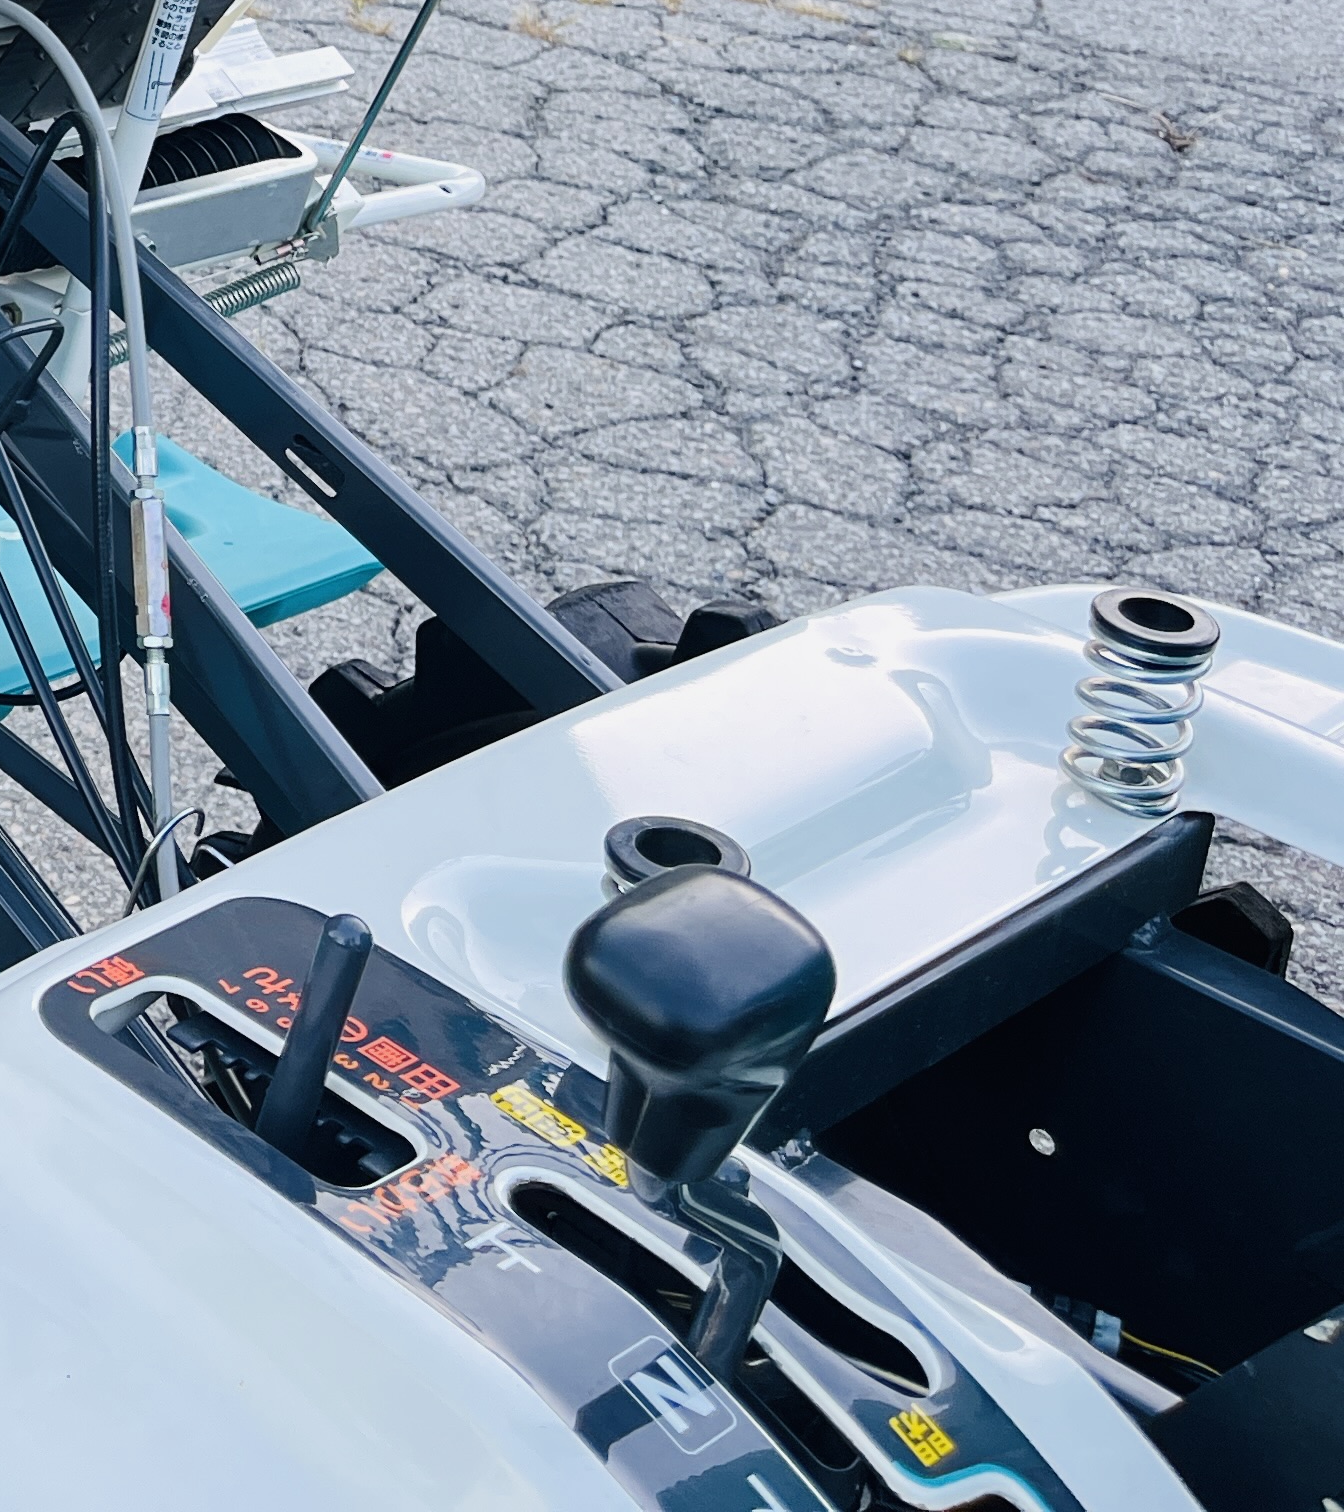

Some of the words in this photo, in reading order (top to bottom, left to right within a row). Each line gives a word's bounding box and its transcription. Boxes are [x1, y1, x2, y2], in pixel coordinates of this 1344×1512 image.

[66, 955, 146, 995] 硬い
[218, 978, 241, 995] 7
[245, 998, 270, 1013] 6
[333, 1053, 359, 1070] 3
[362, 1072, 390, 1091] 2
[629, 1351, 717, 1435] N
